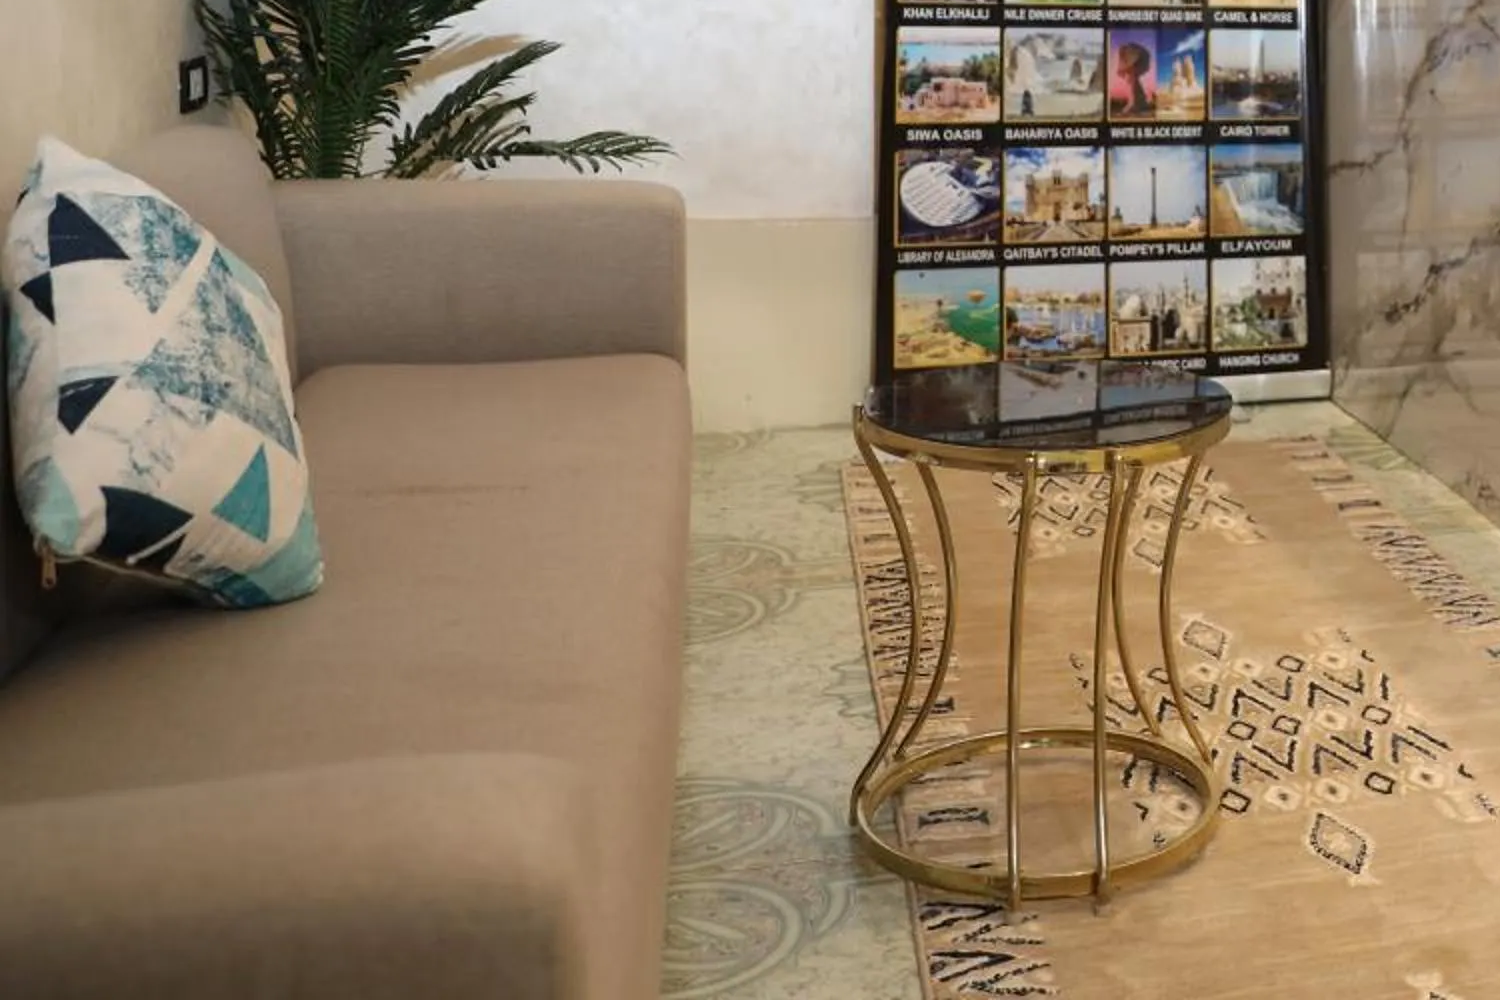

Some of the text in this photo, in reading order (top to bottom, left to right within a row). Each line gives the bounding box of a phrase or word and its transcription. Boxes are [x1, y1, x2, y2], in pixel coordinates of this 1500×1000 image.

[903, 7, 935, 19] KHAN
[1004, 8, 1103, 21] NILE DINNER CRUISE
[1214, 11, 1293, 23] CAMEL & HORSE
[906, 128, 983, 141] SIWA OASIS
[1005, 127, 1099, 140] BAHARIYA OASIS
[1111, 127, 1135, 139] WHITE
[1144, 126, 1171, 138] BLACK
[1219, 125, 1252, 137] CAIRO
[1059, 245, 1104, 258] CITADEL
[1109, 241, 1205, 257] POMPEY'S PILLAR
[1221, 239, 1293, 253] ELFAYOUM
[897, 250, 932, 264] LIBRARY
[934, 250, 945, 263] OF
[1218, 353, 1300, 368] HANGING CHURCH
